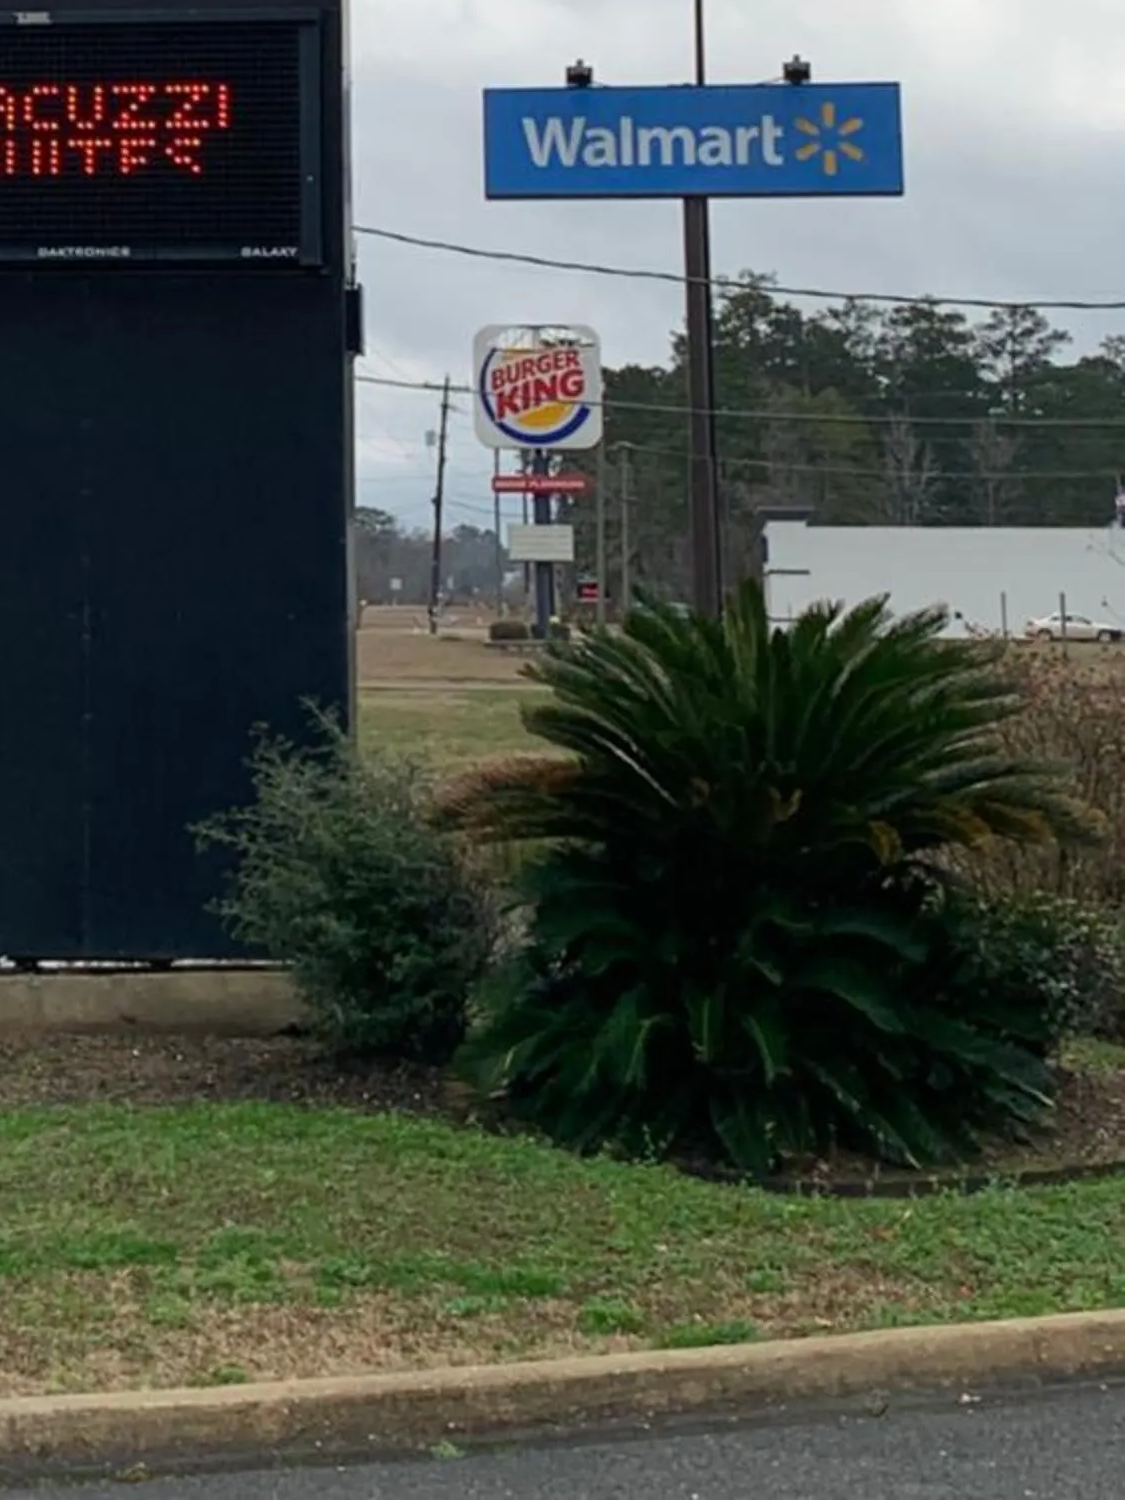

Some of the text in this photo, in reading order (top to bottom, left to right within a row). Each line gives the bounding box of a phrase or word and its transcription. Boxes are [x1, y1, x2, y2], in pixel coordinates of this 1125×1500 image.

[523, 116, 782, 167] Walmart
[491, 350, 579, 391] BURGER
[496, 369, 584, 418] KING
